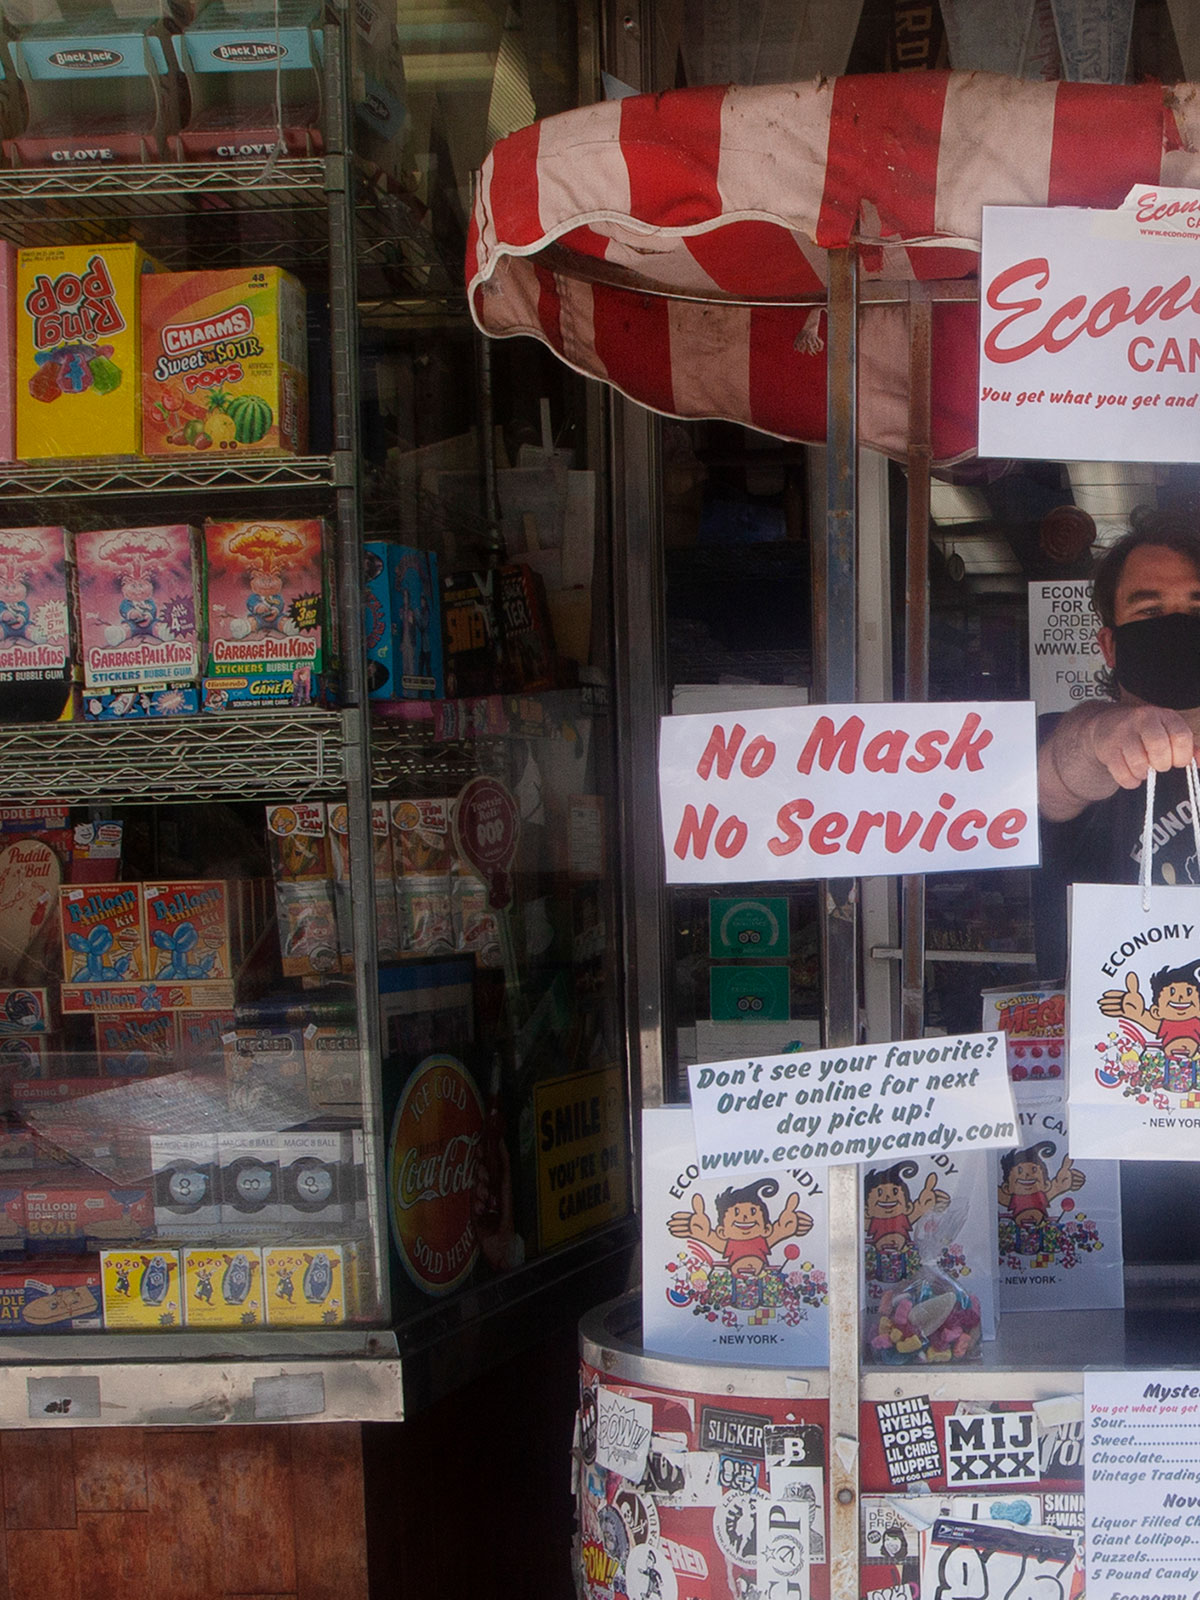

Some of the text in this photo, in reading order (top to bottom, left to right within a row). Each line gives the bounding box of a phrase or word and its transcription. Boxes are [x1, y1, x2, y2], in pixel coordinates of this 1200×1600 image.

[56, 51, 113, 64] Black Jack
[220, 44, 277, 58] Black Jack
[52, 149, 113, 161] CLOVE
[217, 144, 278, 156] CLOVE
[27, 256, 116, 319] Pop
[252, 274, 265, 282] 48
[34, 296, 126, 350] Ring
[167, 312, 248, 350] CHARMS
[155, 338, 262, 381] Sweet SOUR
[183, 363, 244, 393] POPS
[981, 388, 1011, 401] You
[1016, 391, 1045, 406] get
[1050, 390, 1092, 404] what
[1095, 395, 1127, 409] you
[1132, 394, 1160, 410] get
[1165, 394, 1198, 407] and
[1052, 601, 1083, 612] FOR
[1044, 629, 1074, 640] FOR
[91, 645, 192, 669] GARBAGE PAIL KIDS
[214, 638, 315, 661] GARBAGE PAIL KIDS
[92, 667, 192, 682] STICKERS BUBBLE GUM
[215, 662, 295, 674] STICKERS BUBBLE
[697, 712, 993, 780] No Mask
[673, 793, 1027, 860] No Service
[9, 849, 51, 864] Paddle
[25, 864, 51, 877] Ball
[68, 889, 137, 923] Balloon
[115, 913, 135, 928] Kit
[1102, 925, 1194, 977] ECONOMY
[697, 1037, 998, 1088] Don't see your favorite?
[410, 1075, 467, 1122] ICE COLD
[718, 1068, 979, 1114] Order online for next
[540, 1097, 600, 1152] SMILE
[777, 1097, 935, 1137] day pick up!
[1150, 1118, 1176, 1127] NEW
[283, 1138, 337, 1148] MAGIC 8 BALL
[702, 1120, 1014, 1171] www.economycandy.com
[28, 1203, 77, 1212] BALLOON
[558, 1178, 610, 1221] CAMERA
[414, 1220, 474, 1274] SOLD HERE
[105, 1257, 140, 1270] BOZO
[186, 1259, 222, 1270] BOZO
[1005, 1276, 1055, 1284] NEW YORK
[720, 1335, 777, 1344] NEW YORK
[877, 1398, 929, 1419] NIHIL
[879, 1411, 932, 1434] HYENA
[948, 1415, 1033, 1451] MIJ
[708, 1420, 763, 1448] SLICKER
[883, 1425, 935, 1447] POPS
[886, 1440, 938, 1463] LIL CHRIS
[889, 1455, 940, 1477] MUPPET
[950, 1451, 1036, 1481] XXX
[1092, 1470, 1146, 1484] Vintage
[1092, 1516, 1182, 1531] Liquor Filled
[1092, 1534, 1130, 1545] Giant
[1106, 1568, 1198, 1581] Pound Candy
